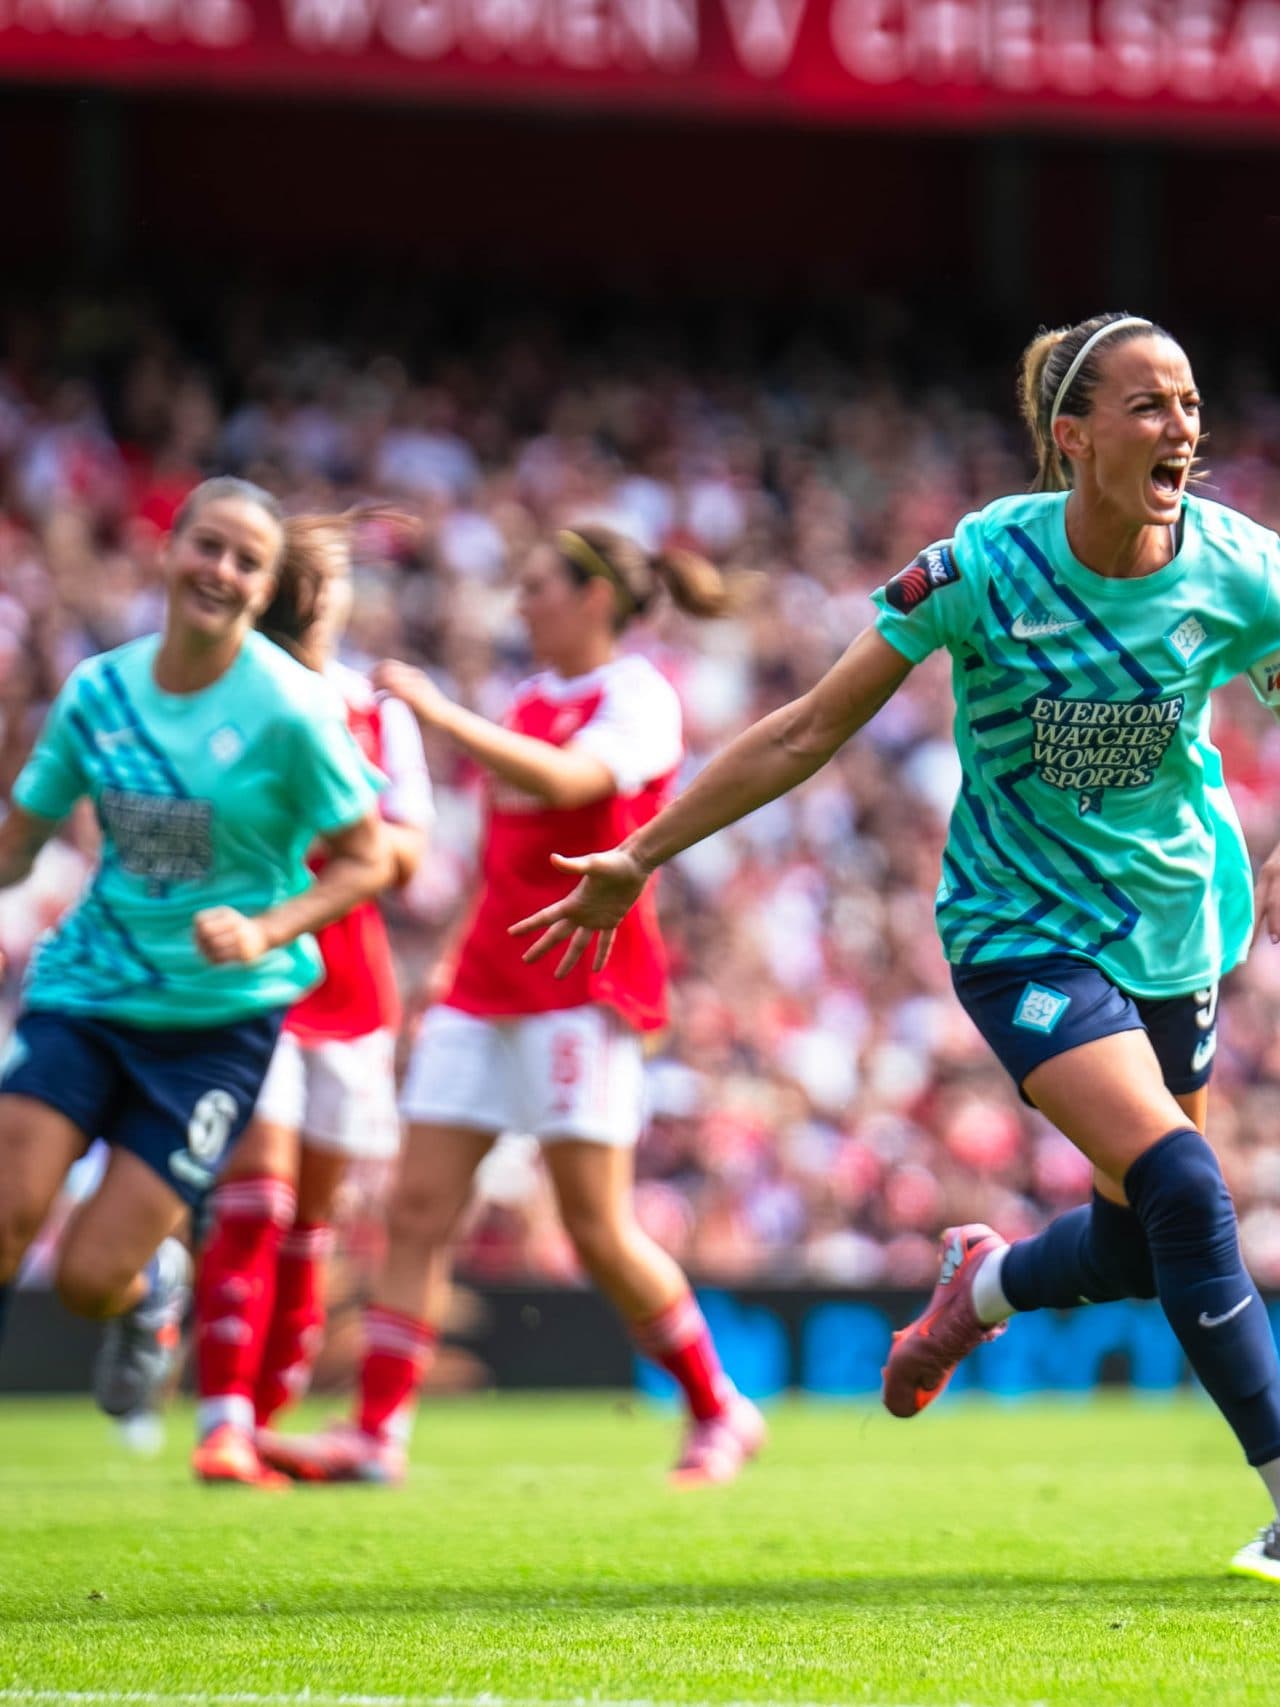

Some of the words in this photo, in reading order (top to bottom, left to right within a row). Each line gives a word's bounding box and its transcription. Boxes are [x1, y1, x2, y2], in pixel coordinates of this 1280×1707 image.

[1030, 697, 1184, 724] EVERYONE
[1034, 722, 1176, 746] WATCHES
[1032, 741, 1168, 768] WOMEN'S
[1041, 764, 1150, 789] SPORTS.
[188, 1088, 239, 1158] 6
